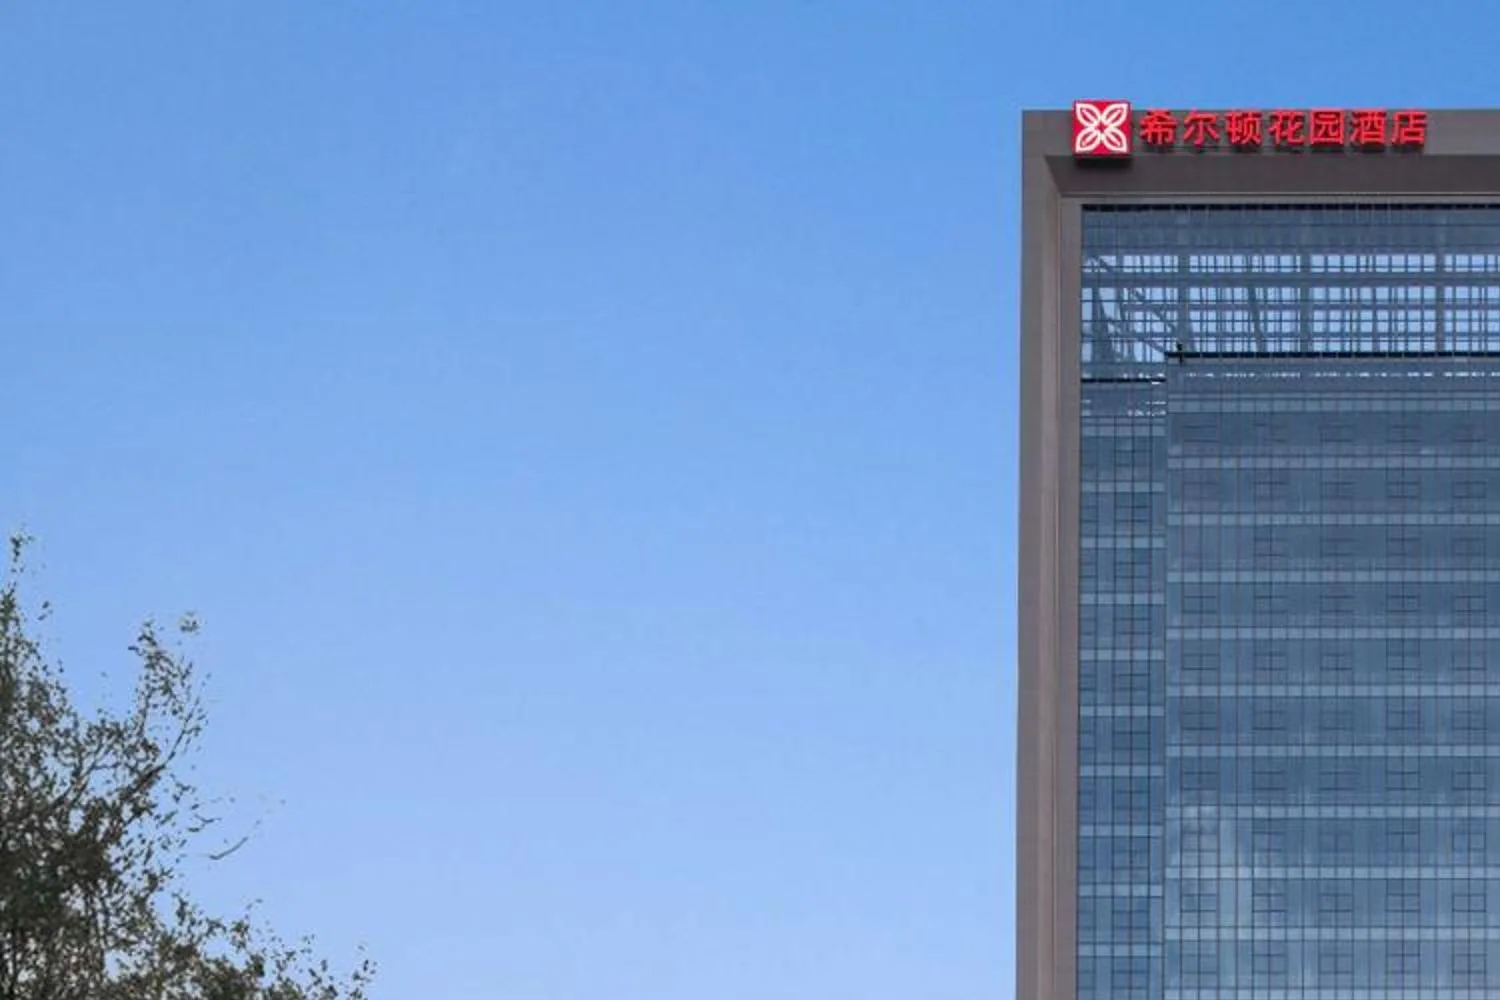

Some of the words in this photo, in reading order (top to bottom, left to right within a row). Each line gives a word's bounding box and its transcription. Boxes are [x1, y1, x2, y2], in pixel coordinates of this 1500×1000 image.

[1140, 109, 1426, 146] 希尔顿花园酒店
